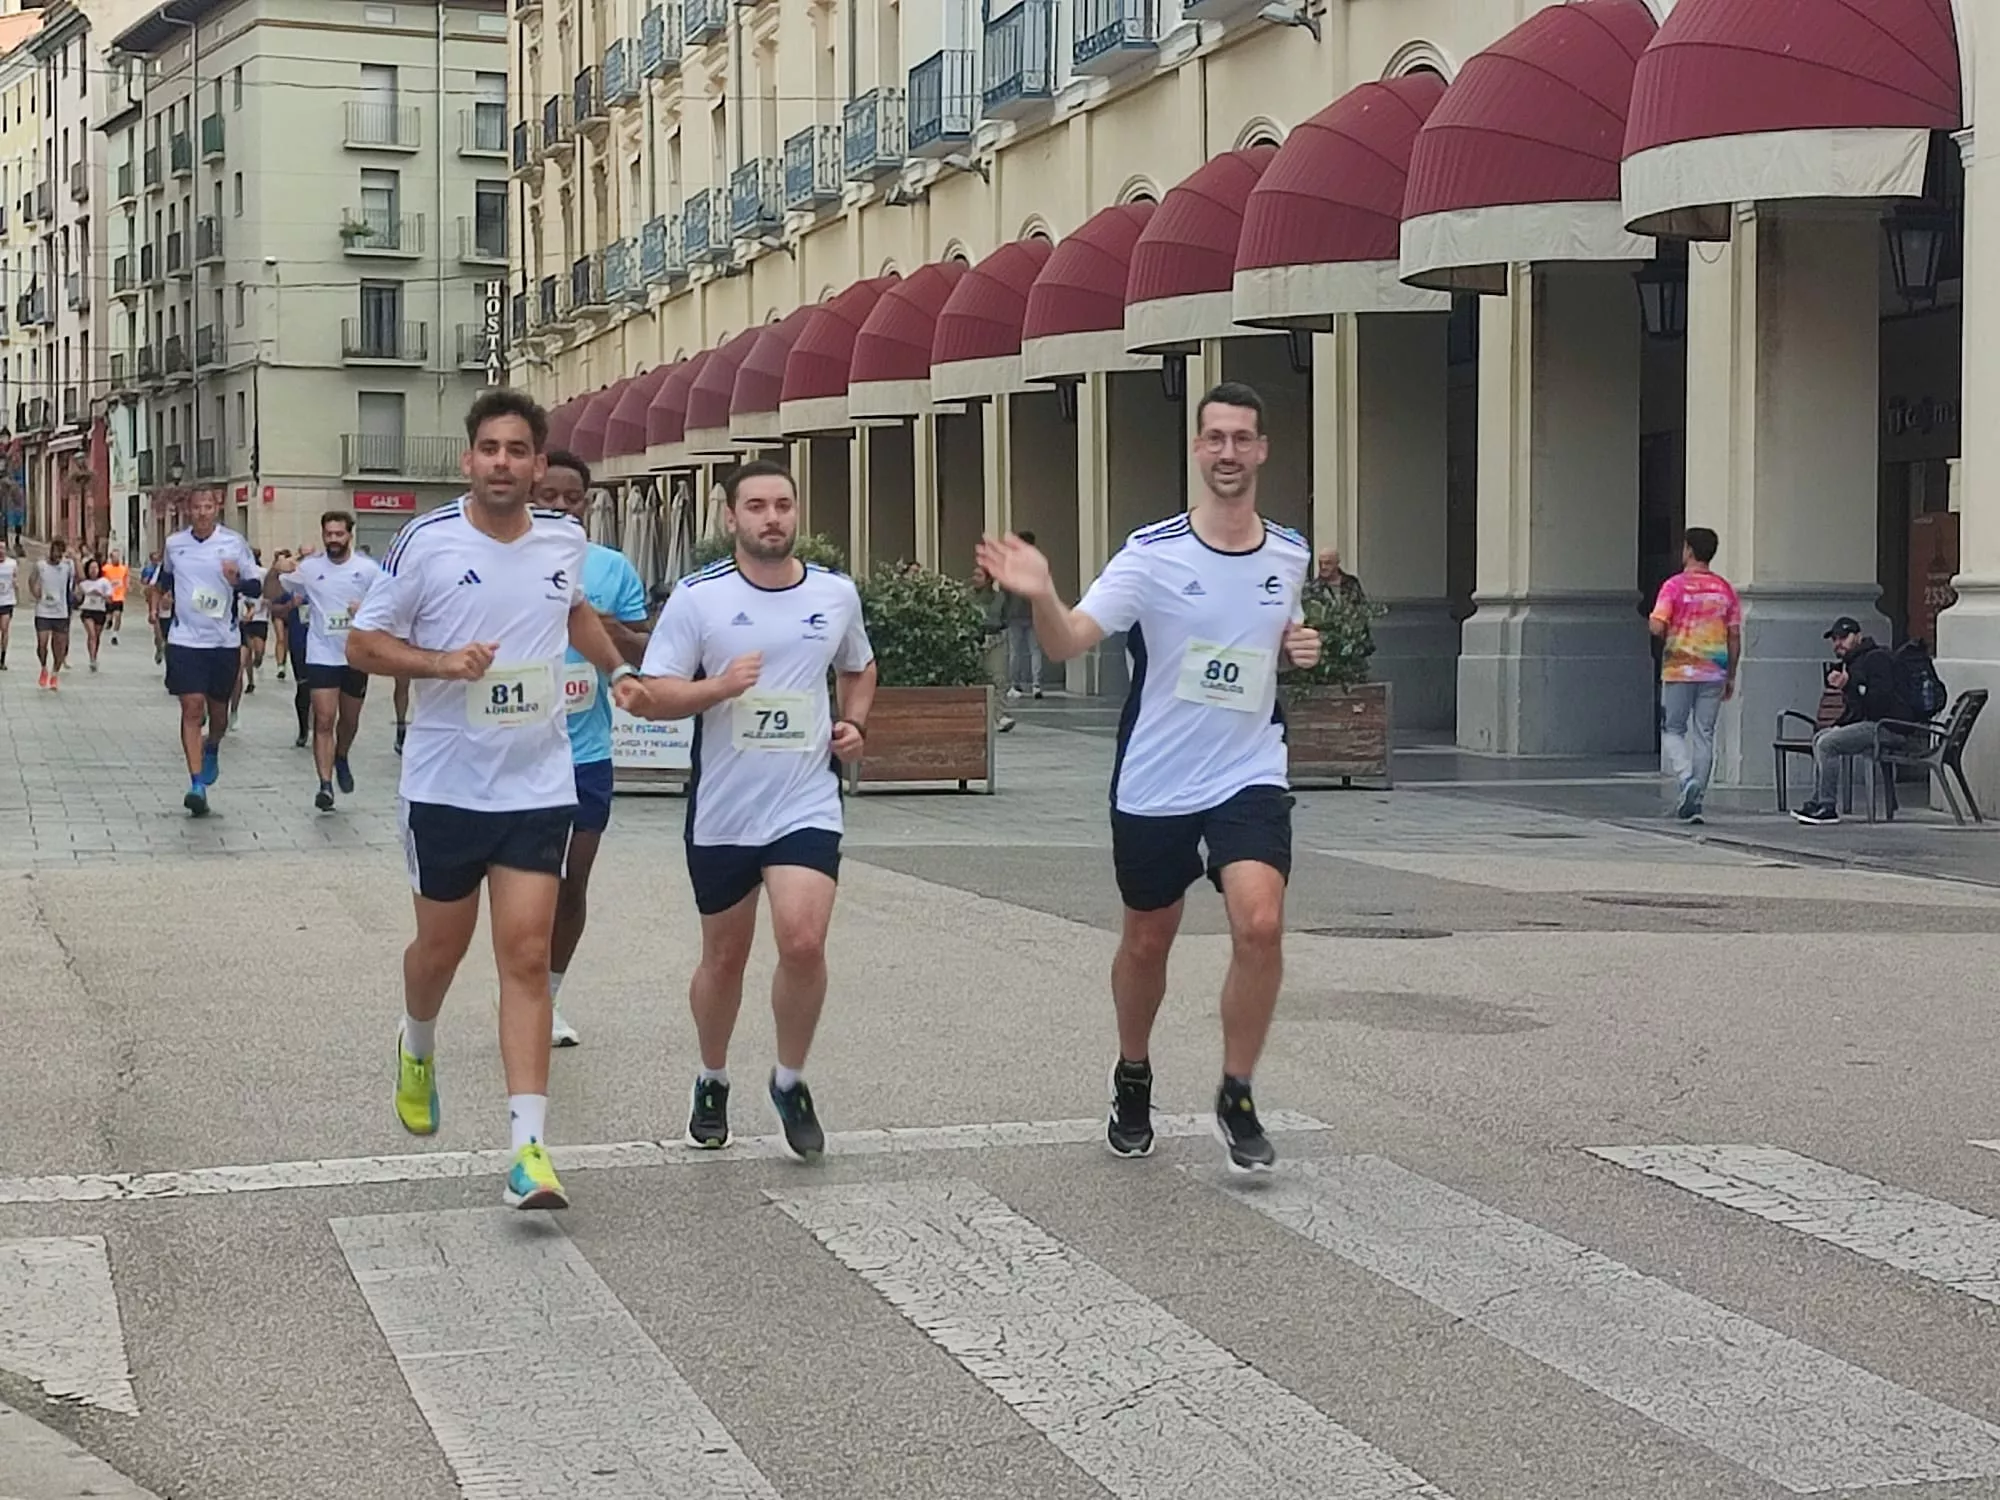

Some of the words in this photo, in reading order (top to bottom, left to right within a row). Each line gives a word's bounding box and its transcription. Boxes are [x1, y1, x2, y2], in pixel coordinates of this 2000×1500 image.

[486, 279, 501, 386] HOSTAL
[1204, 659, 1240, 684] 80
[491, 681, 524, 705] 81
[484, 703, 539, 715] LORENZO
[754, 710, 789, 731] 79
[741, 730, 806, 739] ALEJANDRO
